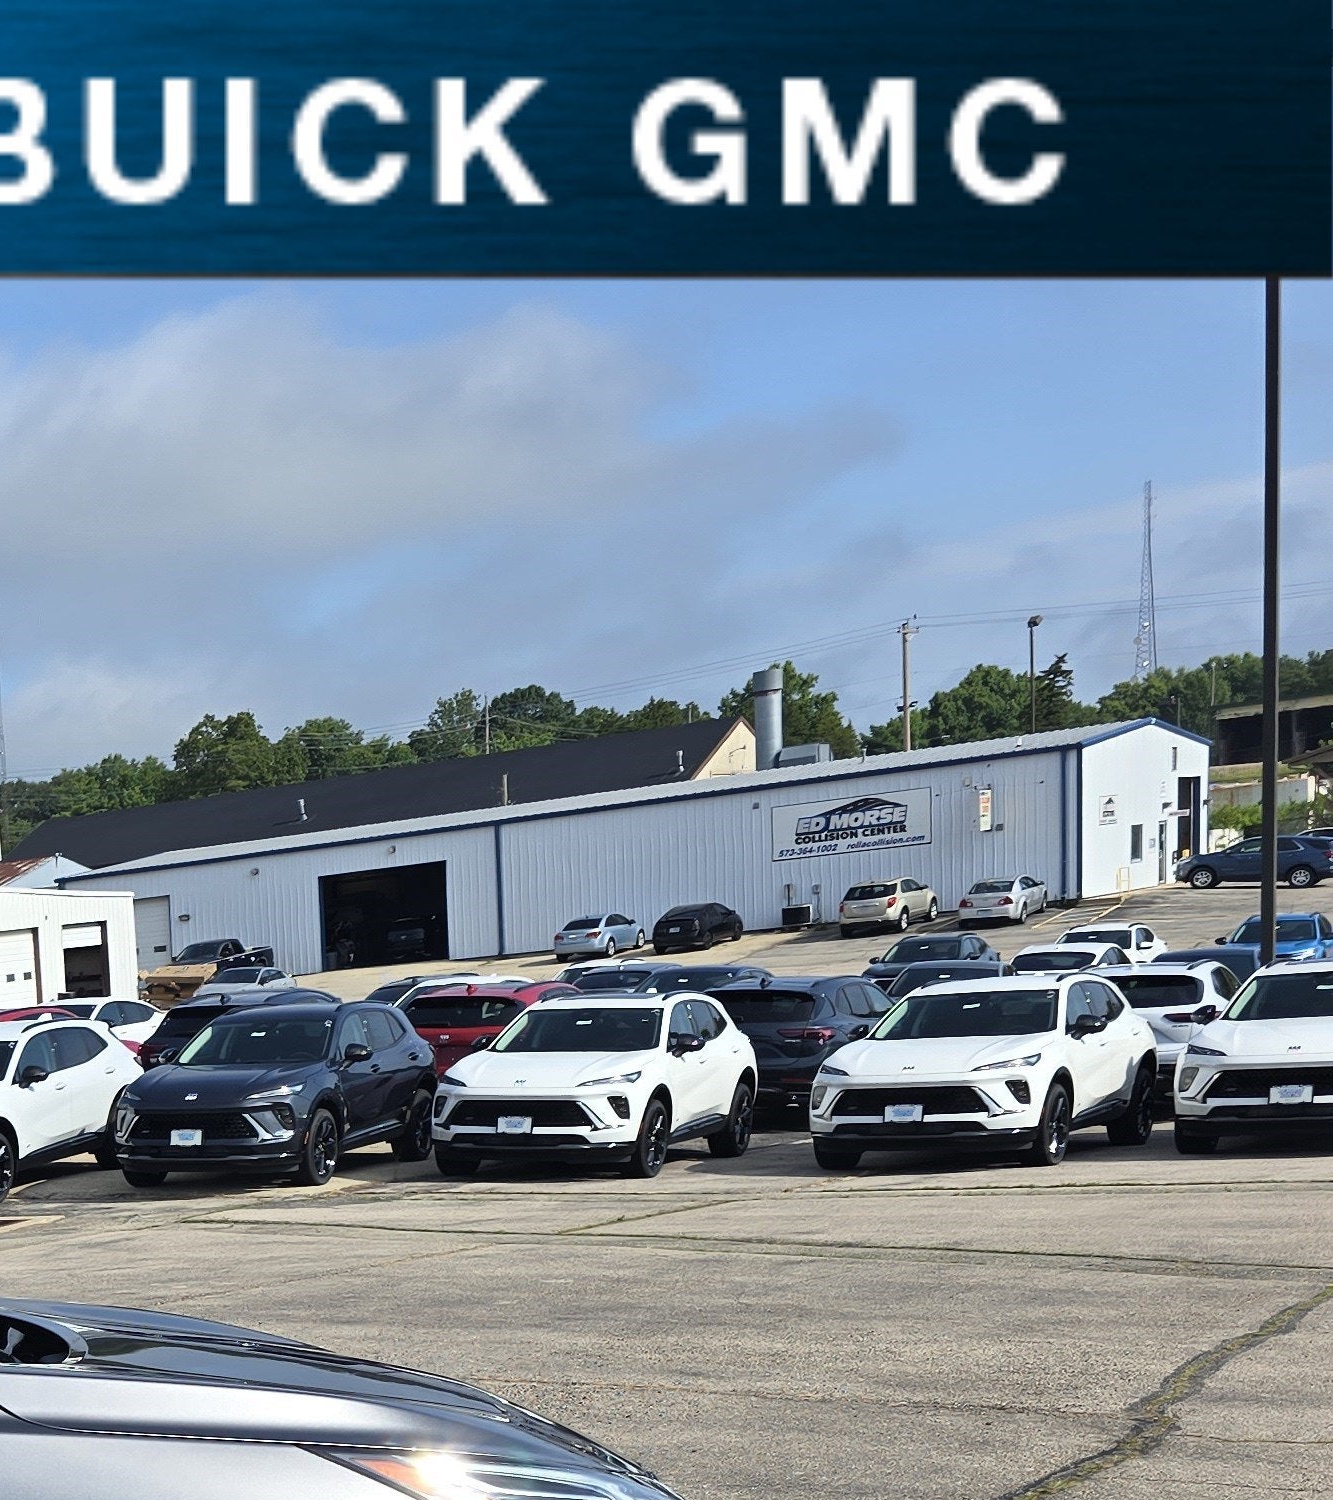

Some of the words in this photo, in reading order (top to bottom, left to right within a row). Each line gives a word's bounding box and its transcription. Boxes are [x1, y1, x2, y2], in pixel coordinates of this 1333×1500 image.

[797, 816, 826, 834] ED
[829, 806, 908, 830] MORSE
[795, 829, 859, 845] COLLISION
[862, 824, 908, 838] CENTER
[778, 843, 839, 858] 573-364-1002
[846, 835, 926, 850] rollacollision.com
